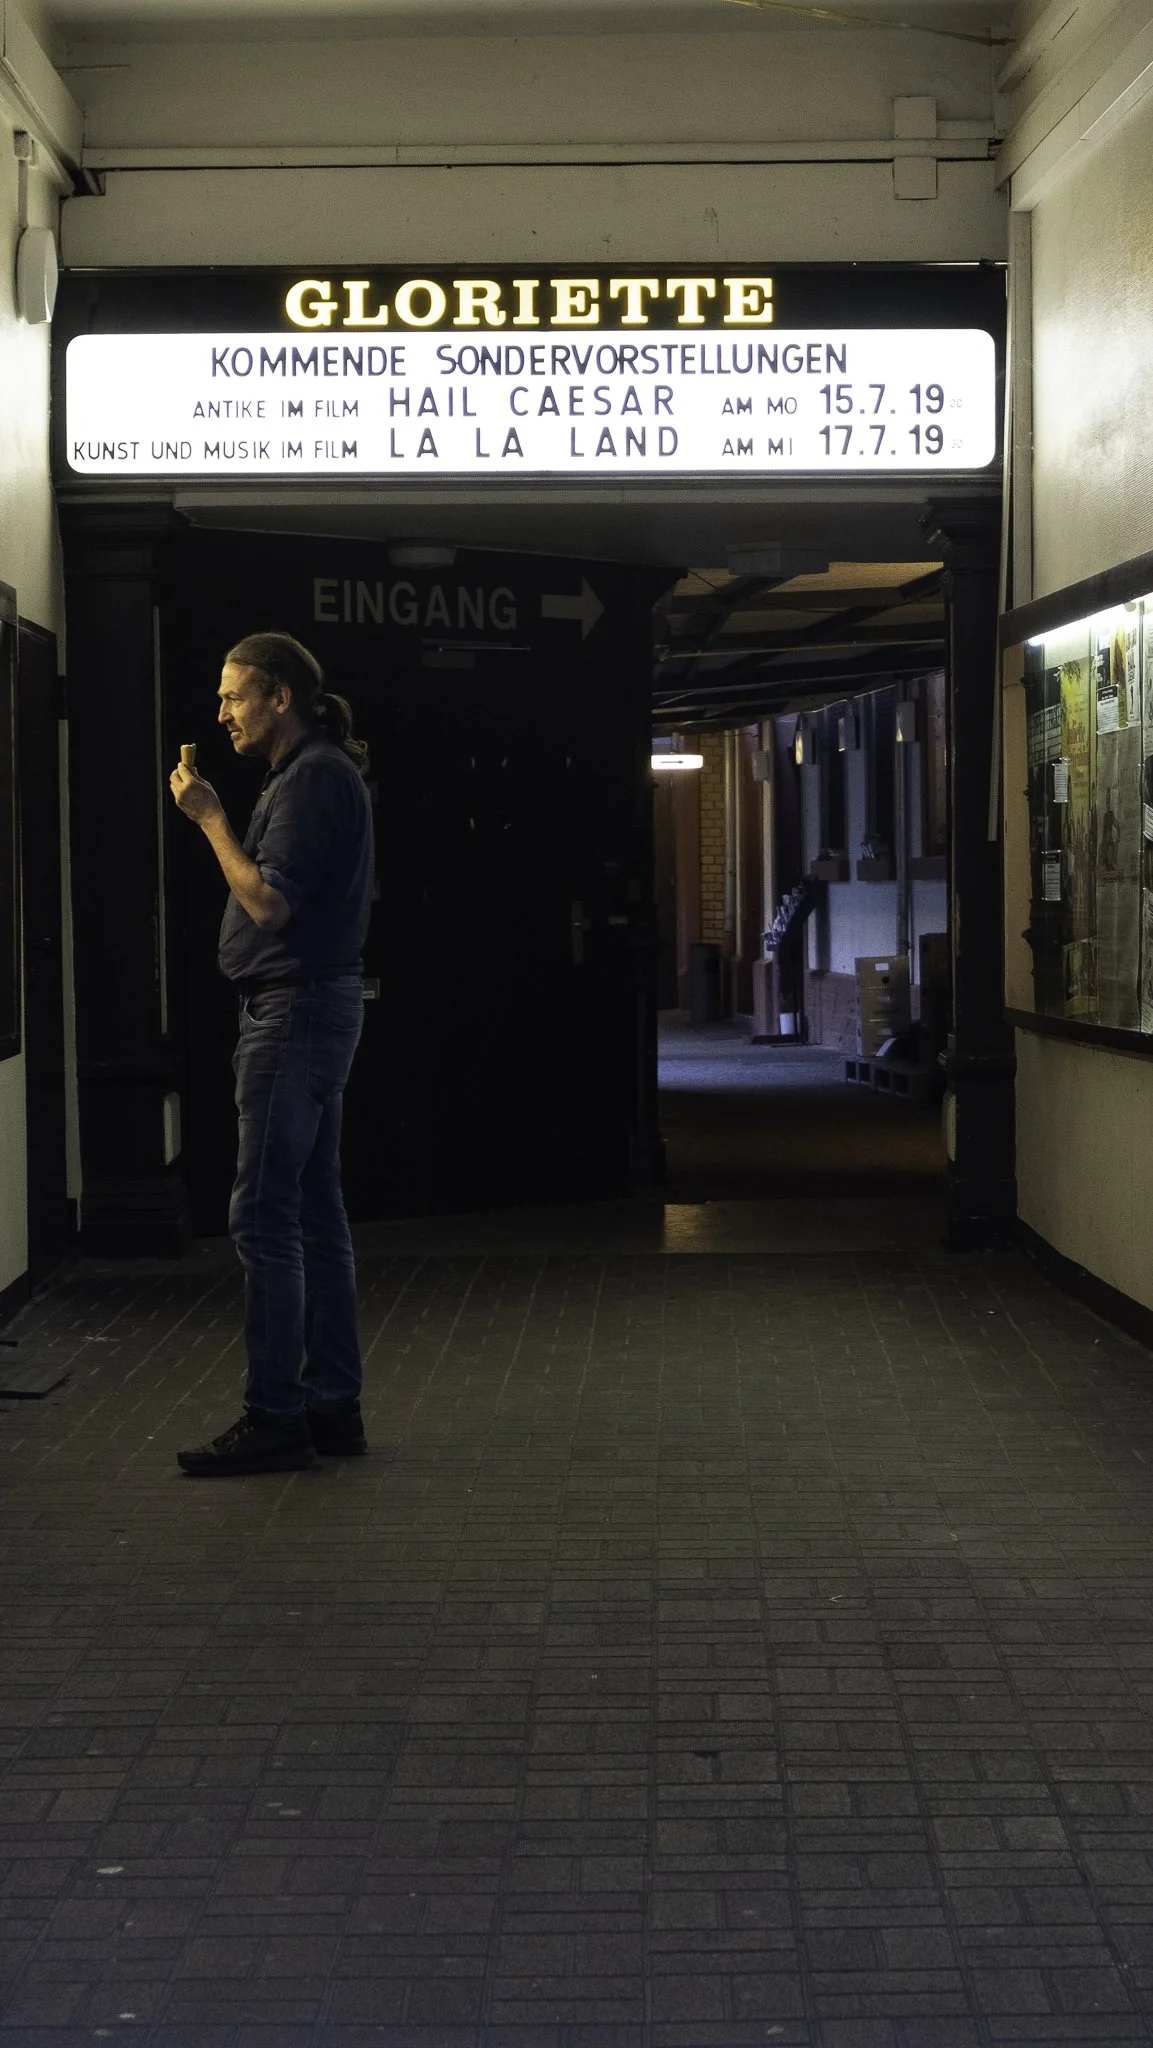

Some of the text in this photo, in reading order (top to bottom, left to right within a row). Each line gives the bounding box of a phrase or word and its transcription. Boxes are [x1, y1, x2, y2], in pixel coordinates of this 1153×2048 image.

[285, 277, 776, 328] GLORIETTE
[212, 344, 846, 377] KOMMENDE SONDERVORSTELLUNGEN
[193, 401, 265, 418] ANTIKE
[282, 400, 303, 417] IM
[316, 400, 358, 417] FILM
[390, 387, 476, 417] HAIL
[510, 385, 673, 416] CAESAR
[722, 397, 752, 415] AM
[768, 397, 797, 414] MO
[75, 442, 139, 460] KUNST
[152, 442, 191, 459] UND
[205, 441, 269, 459] MUSIK
[282, 441, 302, 458] IM
[315, 441, 357, 458] FILM
[391, 428, 438, 458] LA
[476, 427, 524, 457] LA
[571, 426, 678, 457] LAND
[722, 438, 753, 456] AM
[769, 438, 792, 455] MI
[313, 577, 518, 631] EINGANG
